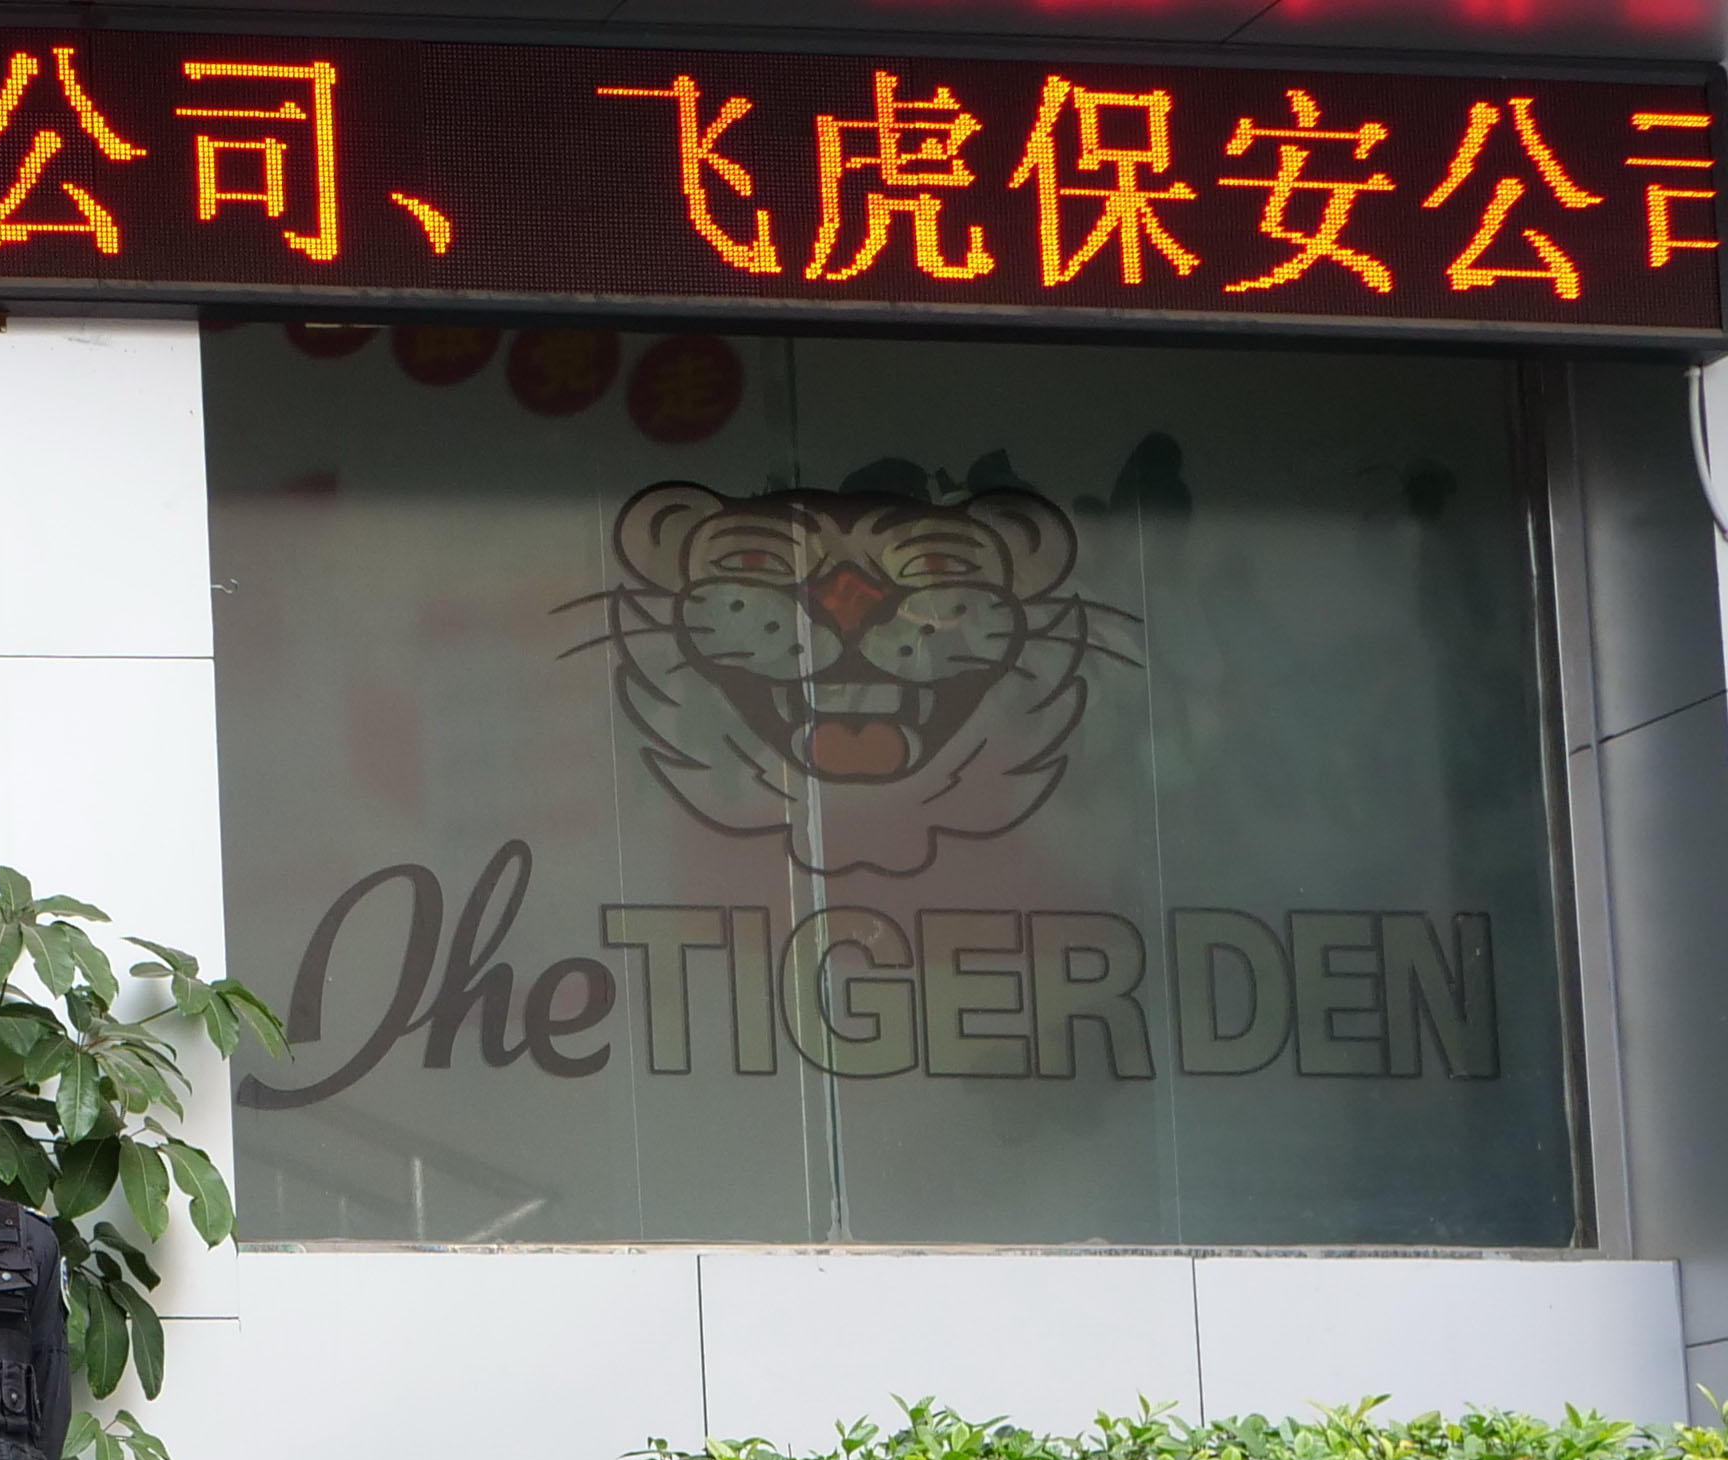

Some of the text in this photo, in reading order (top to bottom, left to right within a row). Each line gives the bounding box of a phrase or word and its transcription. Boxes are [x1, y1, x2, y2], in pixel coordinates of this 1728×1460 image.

[236, 838, 1502, 1112] The TIGER DEN
